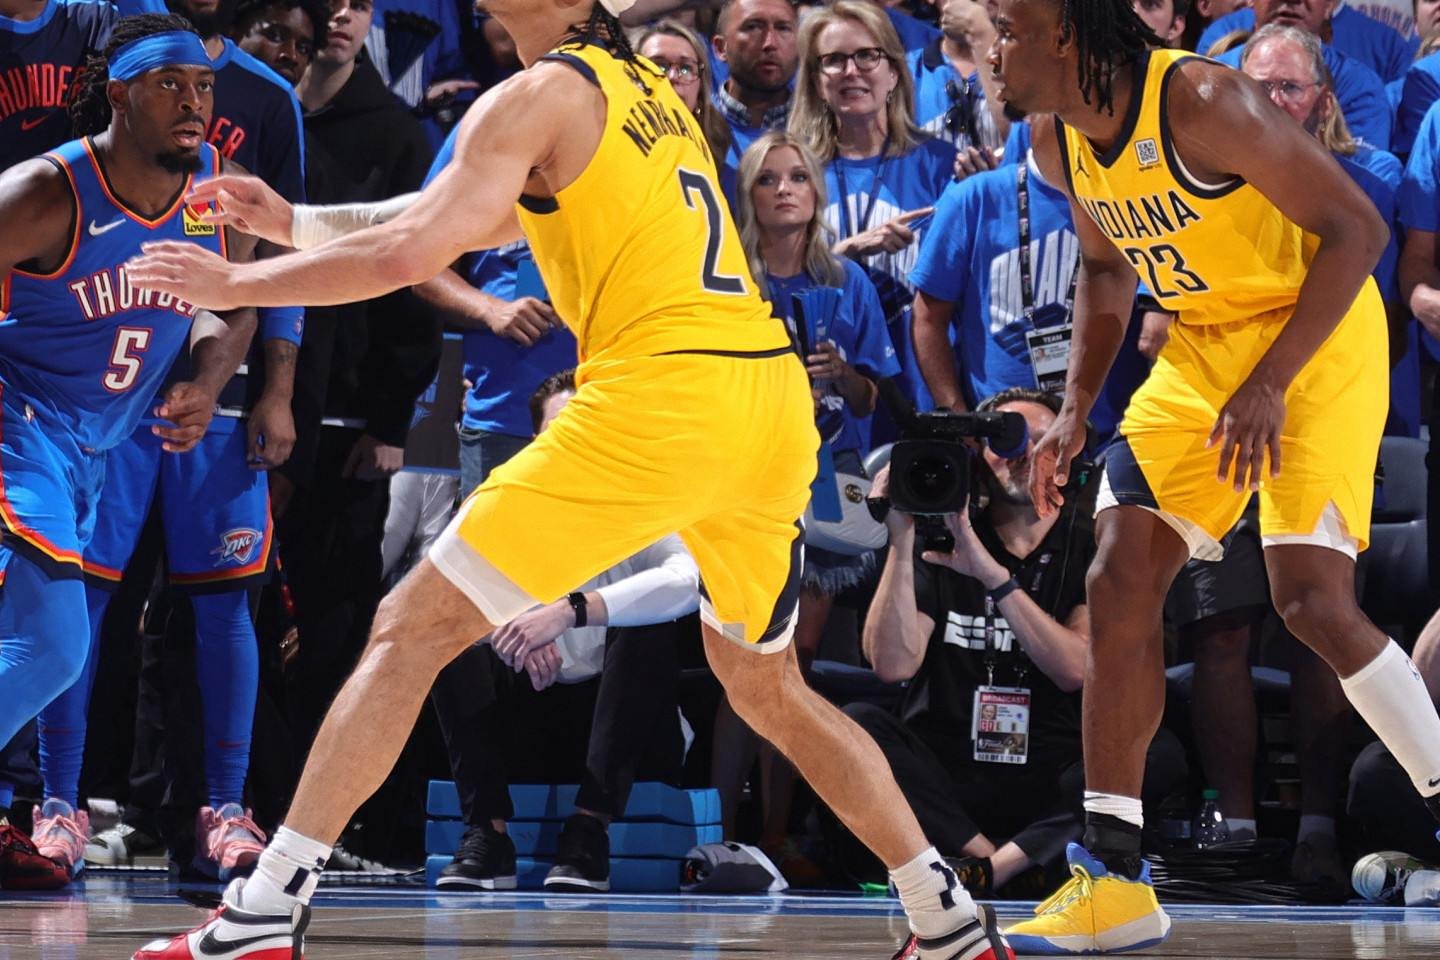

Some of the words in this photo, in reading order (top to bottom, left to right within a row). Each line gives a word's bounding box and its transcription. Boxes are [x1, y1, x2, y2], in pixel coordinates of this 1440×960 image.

[677, 167, 750, 295] 2
[1124, 243, 1210, 299] 23
[102, 326, 153, 392] 5
[223, 534, 252, 558] OKC
[981, 694, 1027, 705] BROADCAST
